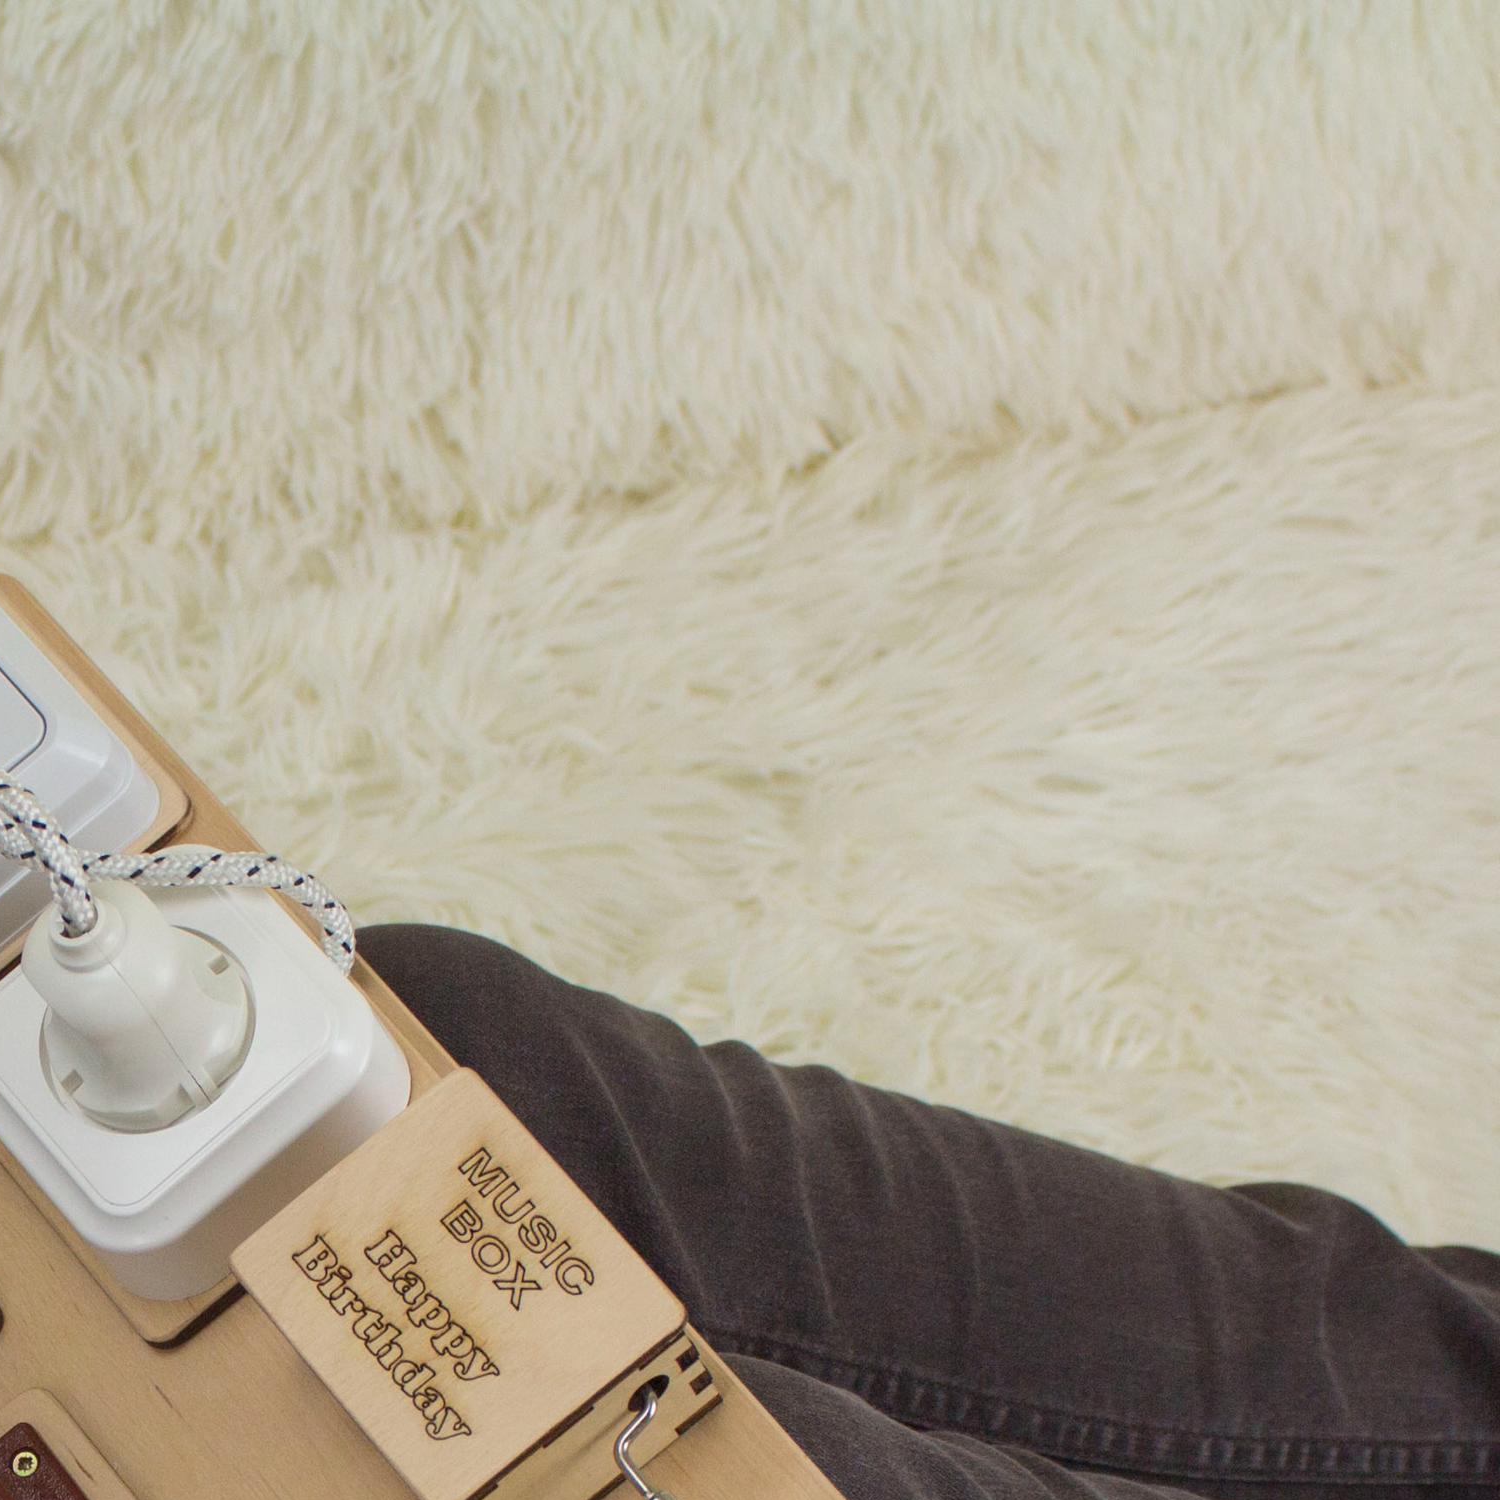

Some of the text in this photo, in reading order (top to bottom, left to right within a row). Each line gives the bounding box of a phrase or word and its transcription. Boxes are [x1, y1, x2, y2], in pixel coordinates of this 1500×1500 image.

[440, 1200, 542, 1311] BOX
[457, 1147, 595, 1296] MUSIC
[291, 1235, 472, 1441] Birthday
[364, 1229, 500, 1381] Happy
